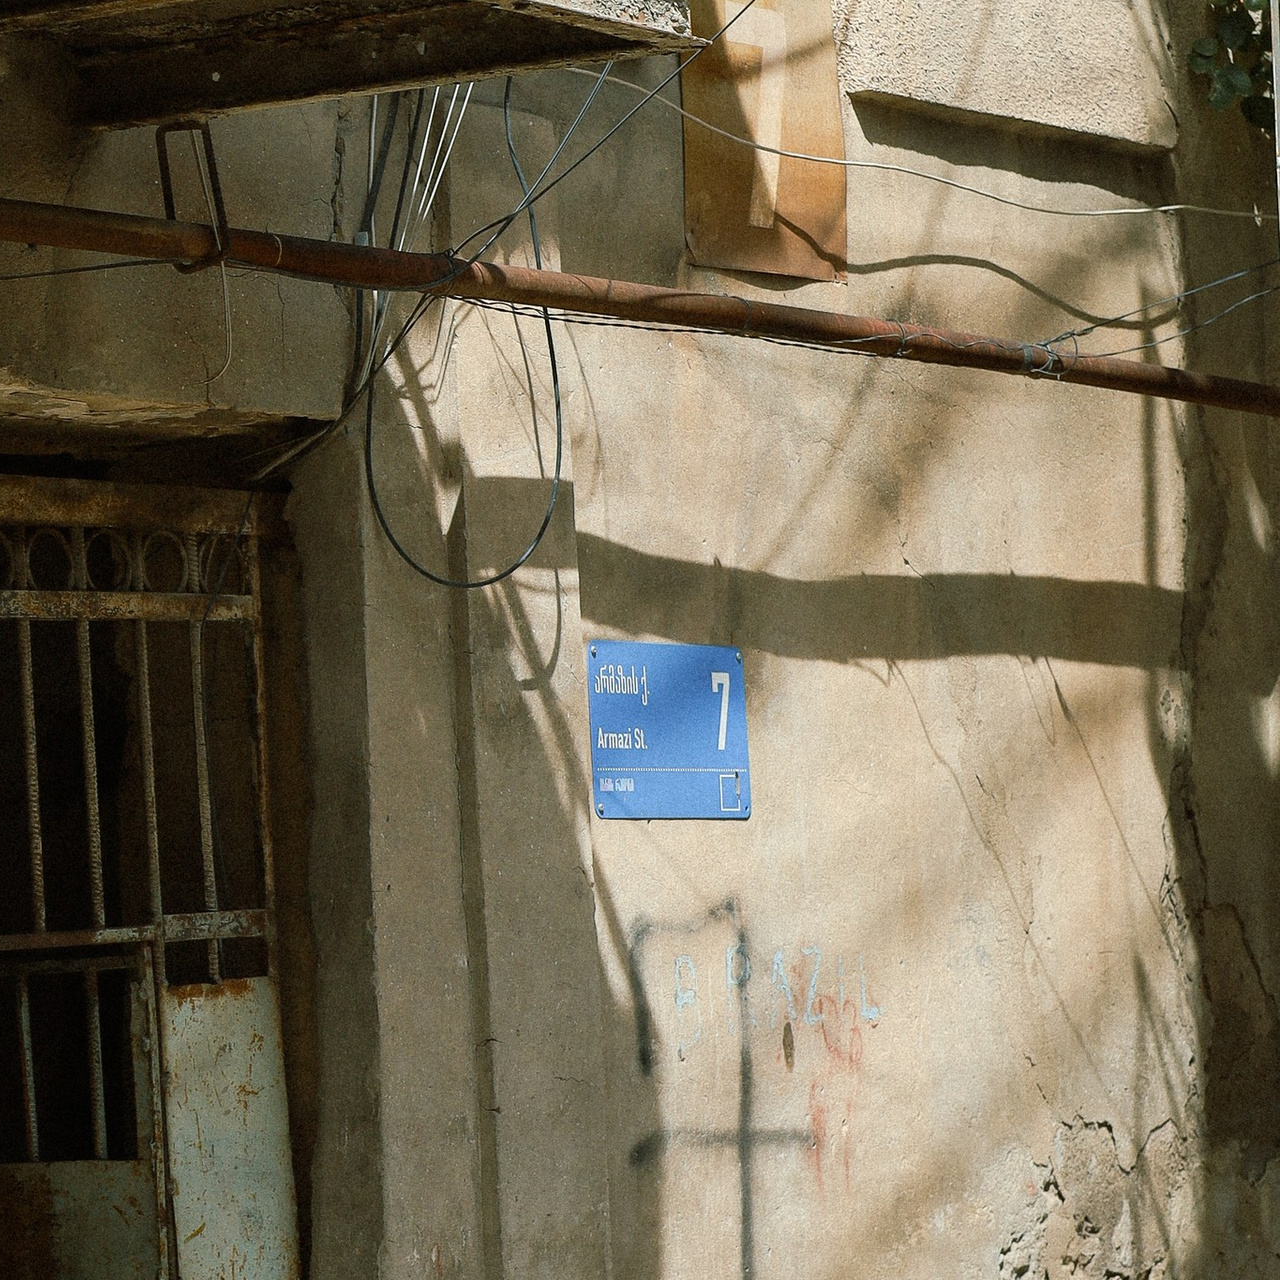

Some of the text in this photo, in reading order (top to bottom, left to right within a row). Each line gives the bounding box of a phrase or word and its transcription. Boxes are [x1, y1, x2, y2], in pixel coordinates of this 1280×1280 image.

[725, 0, 787, 229] 7
[594, 665, 650, 706] არმაზის ქ.
[711, 671, 730, 751] 7
[597, 727, 649, 749] Armazi St.
